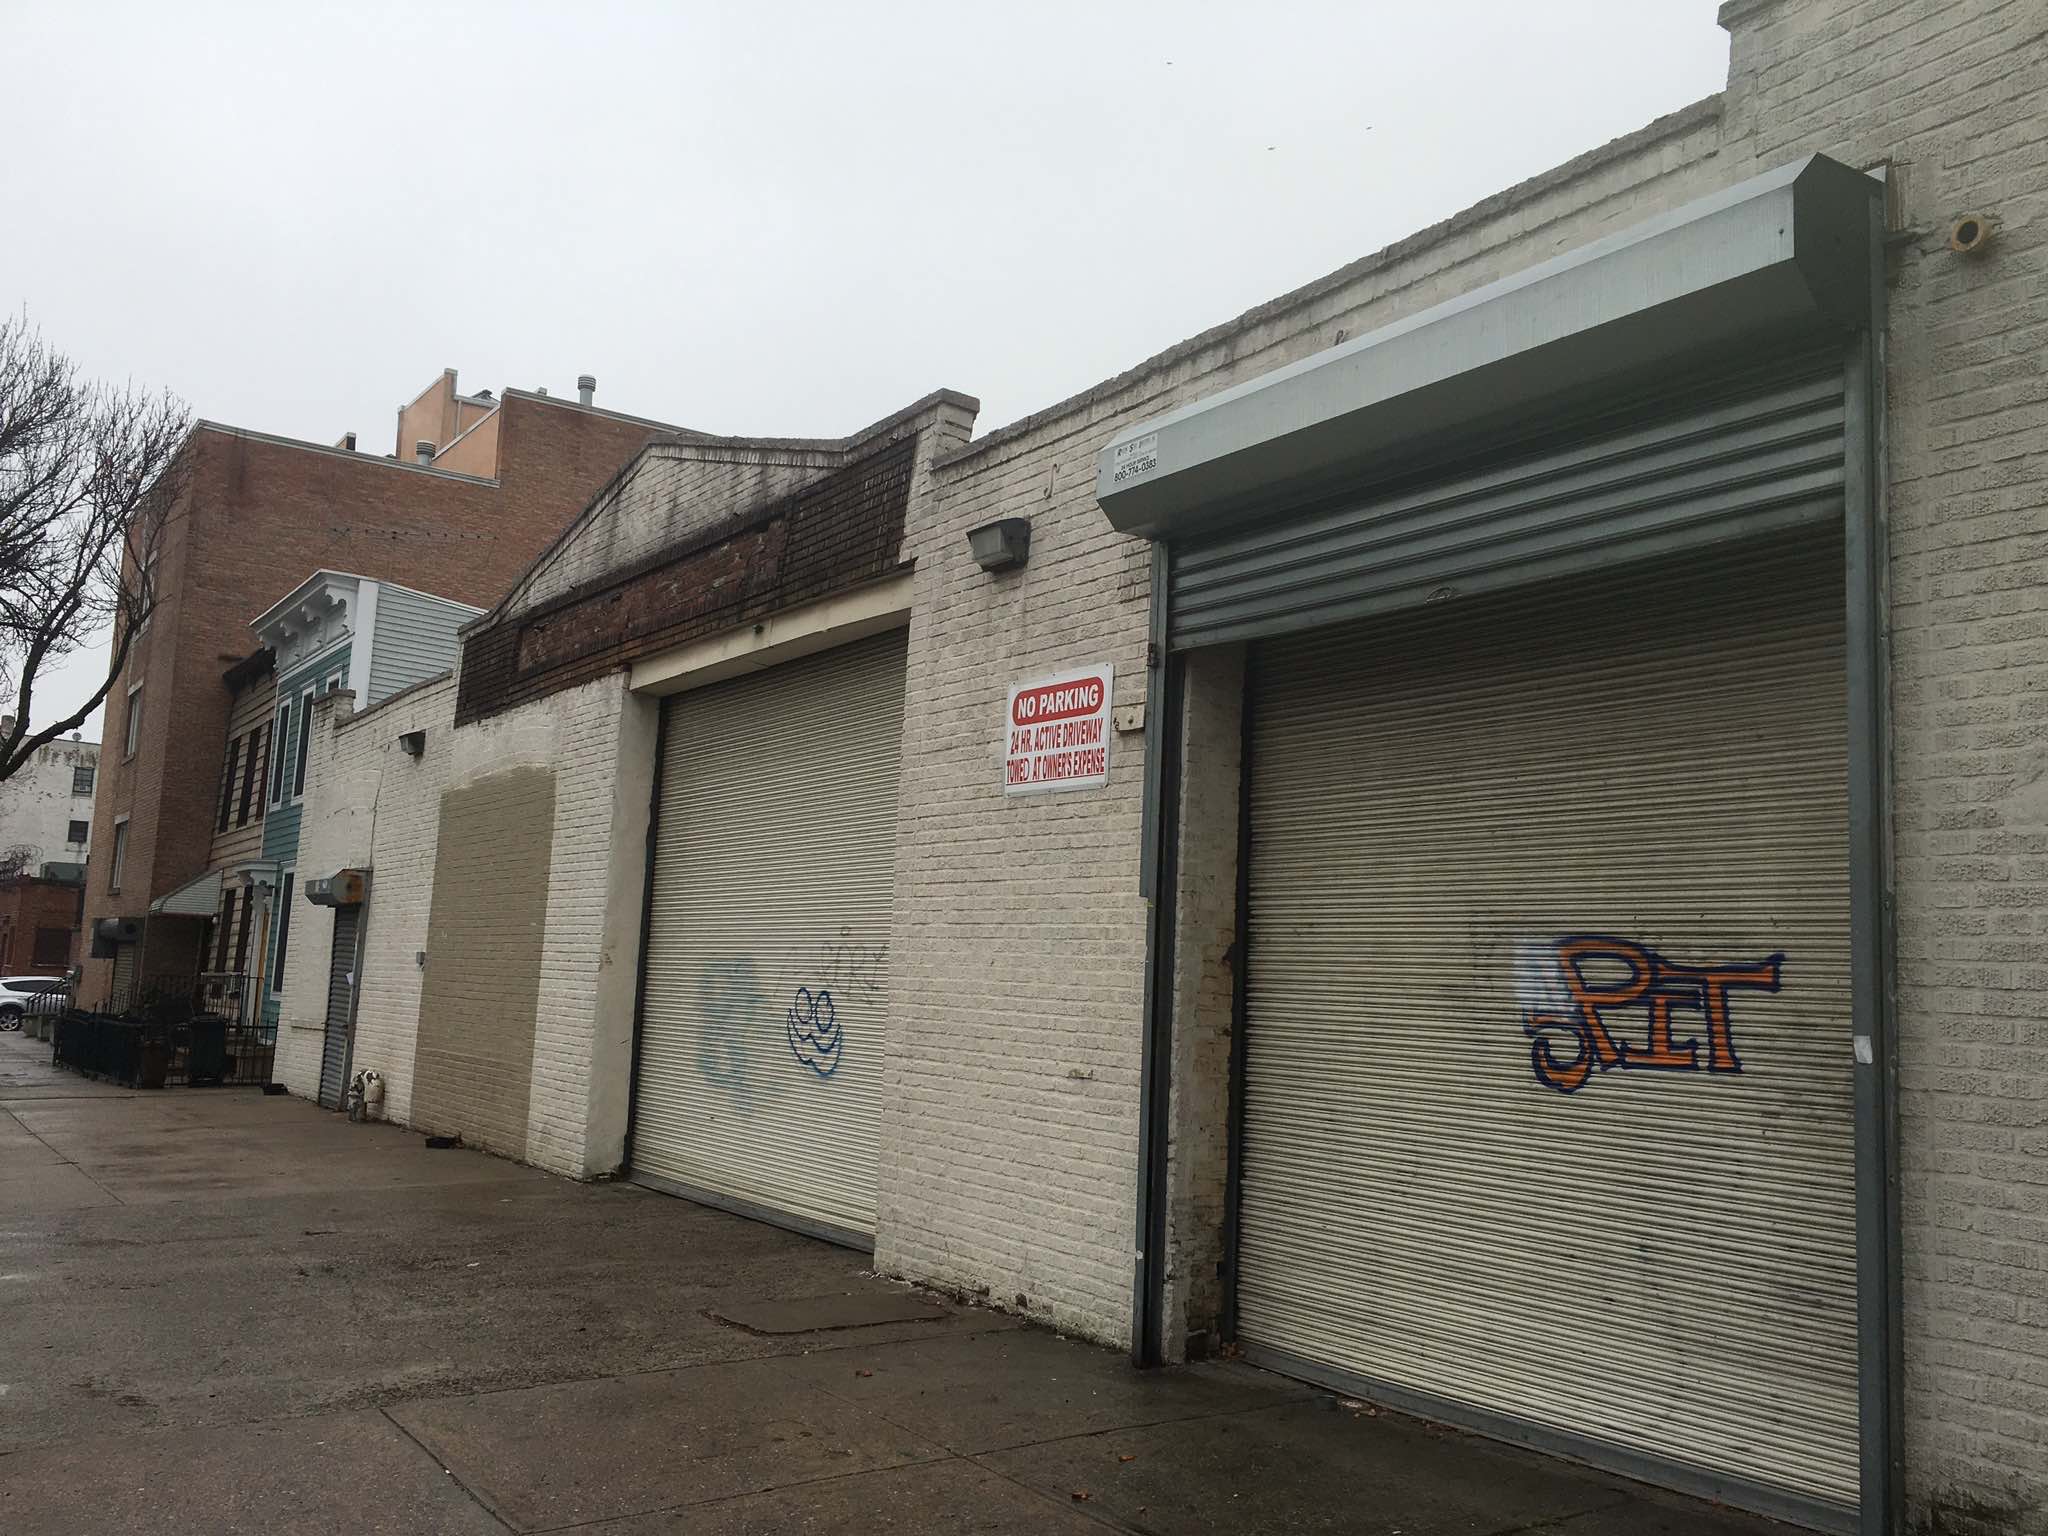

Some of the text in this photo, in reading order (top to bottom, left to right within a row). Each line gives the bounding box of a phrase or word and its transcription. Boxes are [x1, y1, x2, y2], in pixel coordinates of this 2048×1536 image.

[1017, 684, 1099, 719] NO PARKING
[1010, 718, 1104, 755] 24 HR. ACTIVE DRIVEWAY
[1007, 747, 1105, 783] TOWED AT OWNER'S EXPENSE
